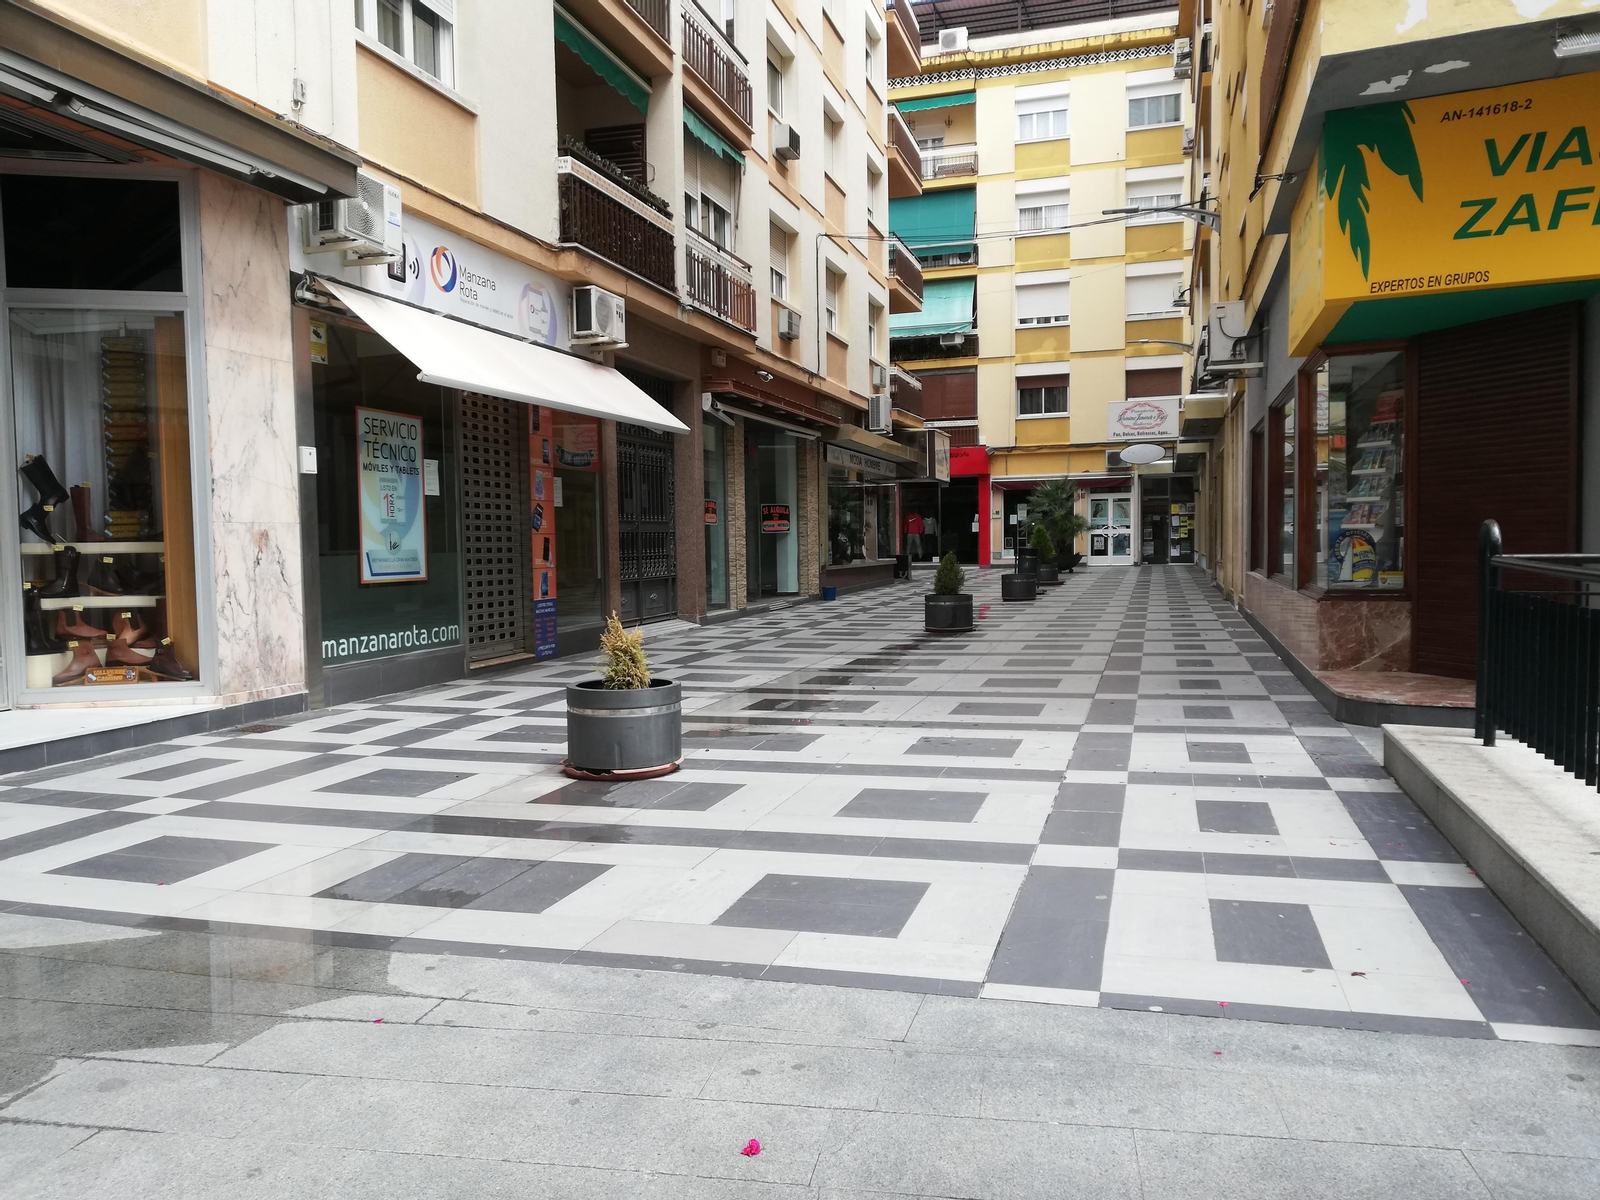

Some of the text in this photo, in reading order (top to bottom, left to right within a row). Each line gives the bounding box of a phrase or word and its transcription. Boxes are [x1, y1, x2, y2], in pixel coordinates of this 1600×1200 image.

[1440, 98, 1533, 123] AN-141618-2
[1485, 125, 1600, 178] VIA
[459, 264, 497, 292] Manzana
[1370, 270, 1490, 294] EXPERTOS EN GRUPOS
[459, 281, 478, 300] Rota
[363, 417, 418, 441] SERVICIO
[363, 437, 417, 463] TÉCNICO
[849, 453, 863, 467] MODA
[864, 457, 881, 471] HOMBRE
[363, 460, 420, 476] MÓVILES Y TABLETS
[762, 505, 790, 515] SE ALQUILA
[1334, 536, 1344, 559] AGENTE
[1345, 529, 1370, 539] OFICIAL
[322, 624, 460, 659] manzanarota.com
